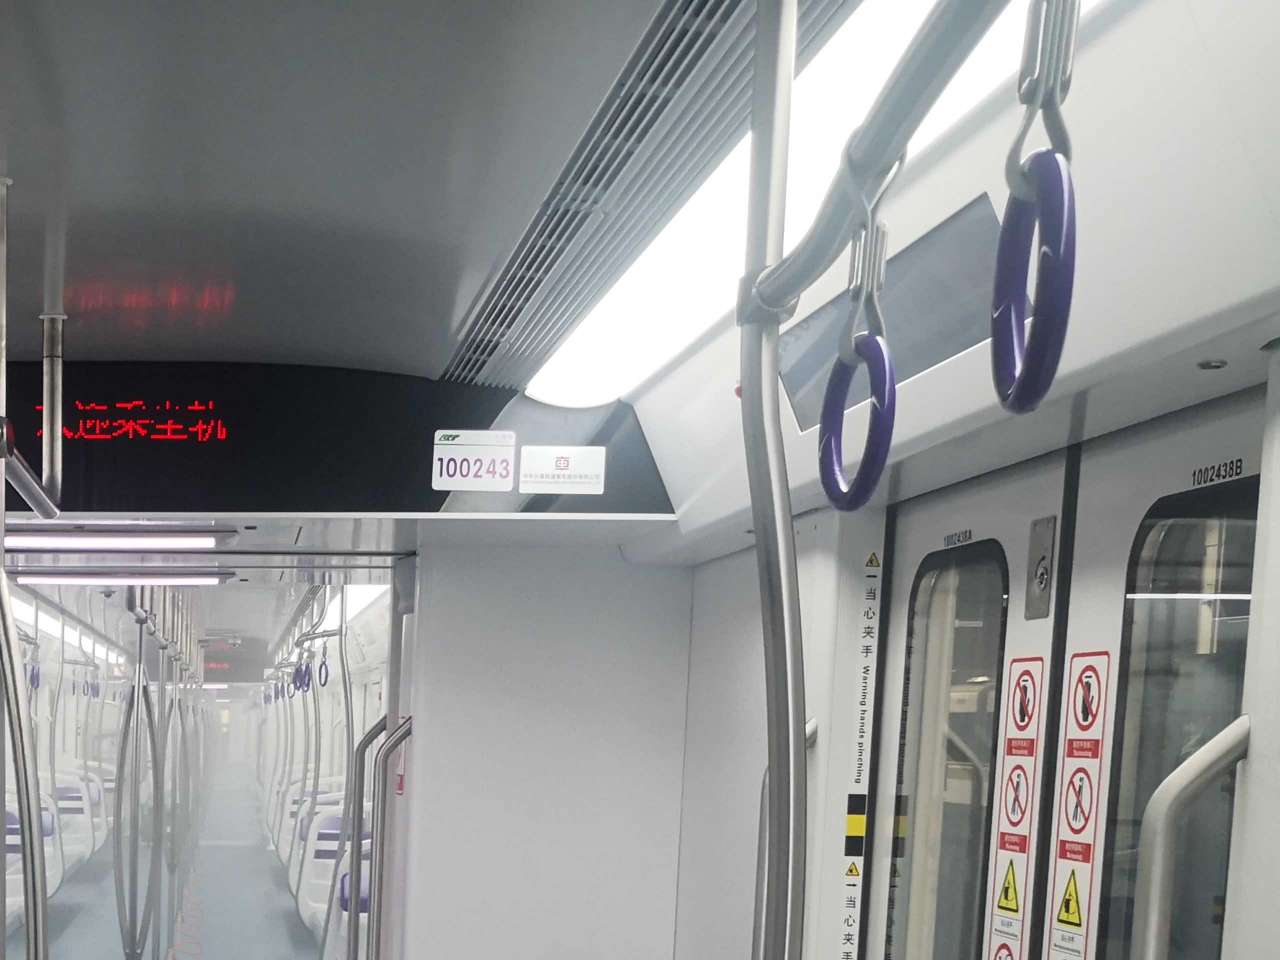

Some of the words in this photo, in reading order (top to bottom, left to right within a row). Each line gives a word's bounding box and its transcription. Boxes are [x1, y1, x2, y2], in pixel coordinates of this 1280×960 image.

[437, 457, 510, 479] 100243
[1192, 458, 1243, 487] 1002438B
[861, 587, 877, 658] 当心夹手
[859, 665, 870, 706] Warning
[858, 709, 868, 739] hands
[854, 742, 865, 784] pinching
